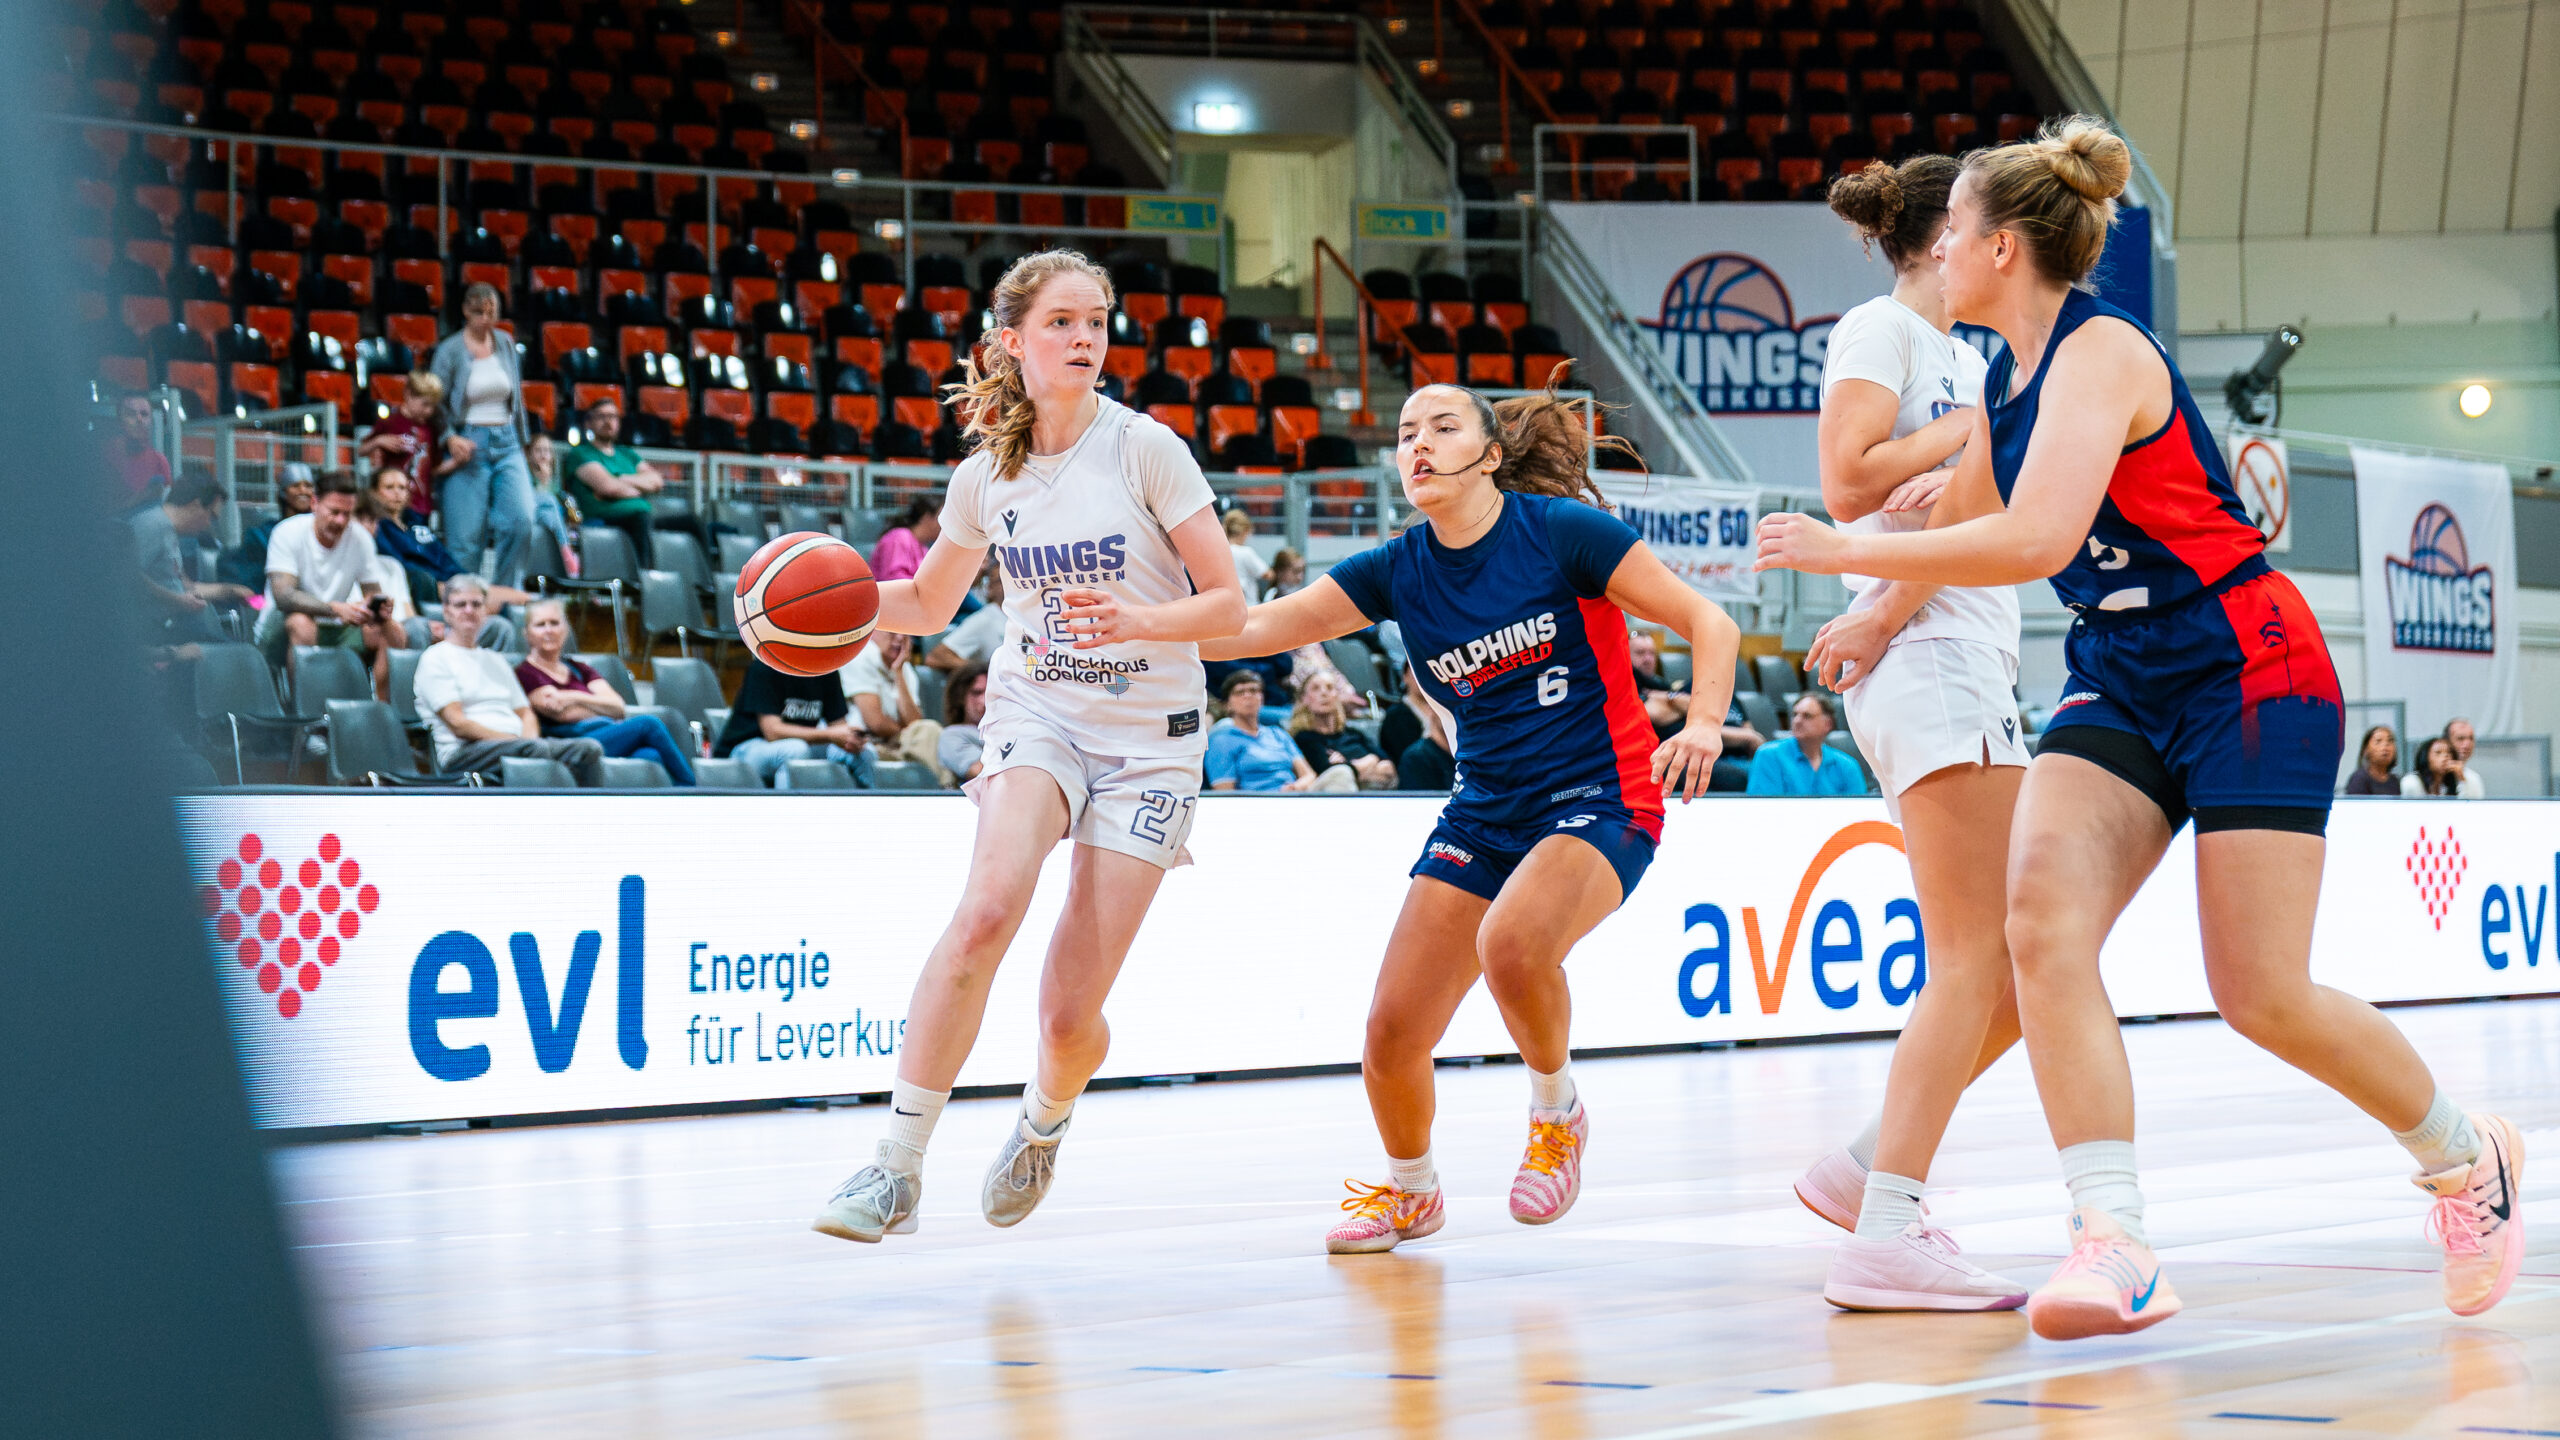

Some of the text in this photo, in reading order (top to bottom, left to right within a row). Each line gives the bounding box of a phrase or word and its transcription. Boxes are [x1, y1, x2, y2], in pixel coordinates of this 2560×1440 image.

[998, 534, 1126, 579] WINGS
[1013, 570, 1126, 590] LEVERKUSEN
[1041, 586, 1097, 642] 2
[2387, 562, 2492, 629] WINGS
[1045, 650, 1149, 673] druckhaus
[1426, 612, 1557, 684] DOLPHINS
[1467, 642, 1553, 688] BIELEFELD
[1035, 667, 1111, 684] boeken
[1537, 665, 1569, 706] 6
[1428, 841, 1474, 864] DOLPHINS
[1678, 820, 1926, 1018] avea
[407, 874, 649, 1082] evl
[690, 938, 829, 1003] Energie
[686, 1014, 744, 1066] für
